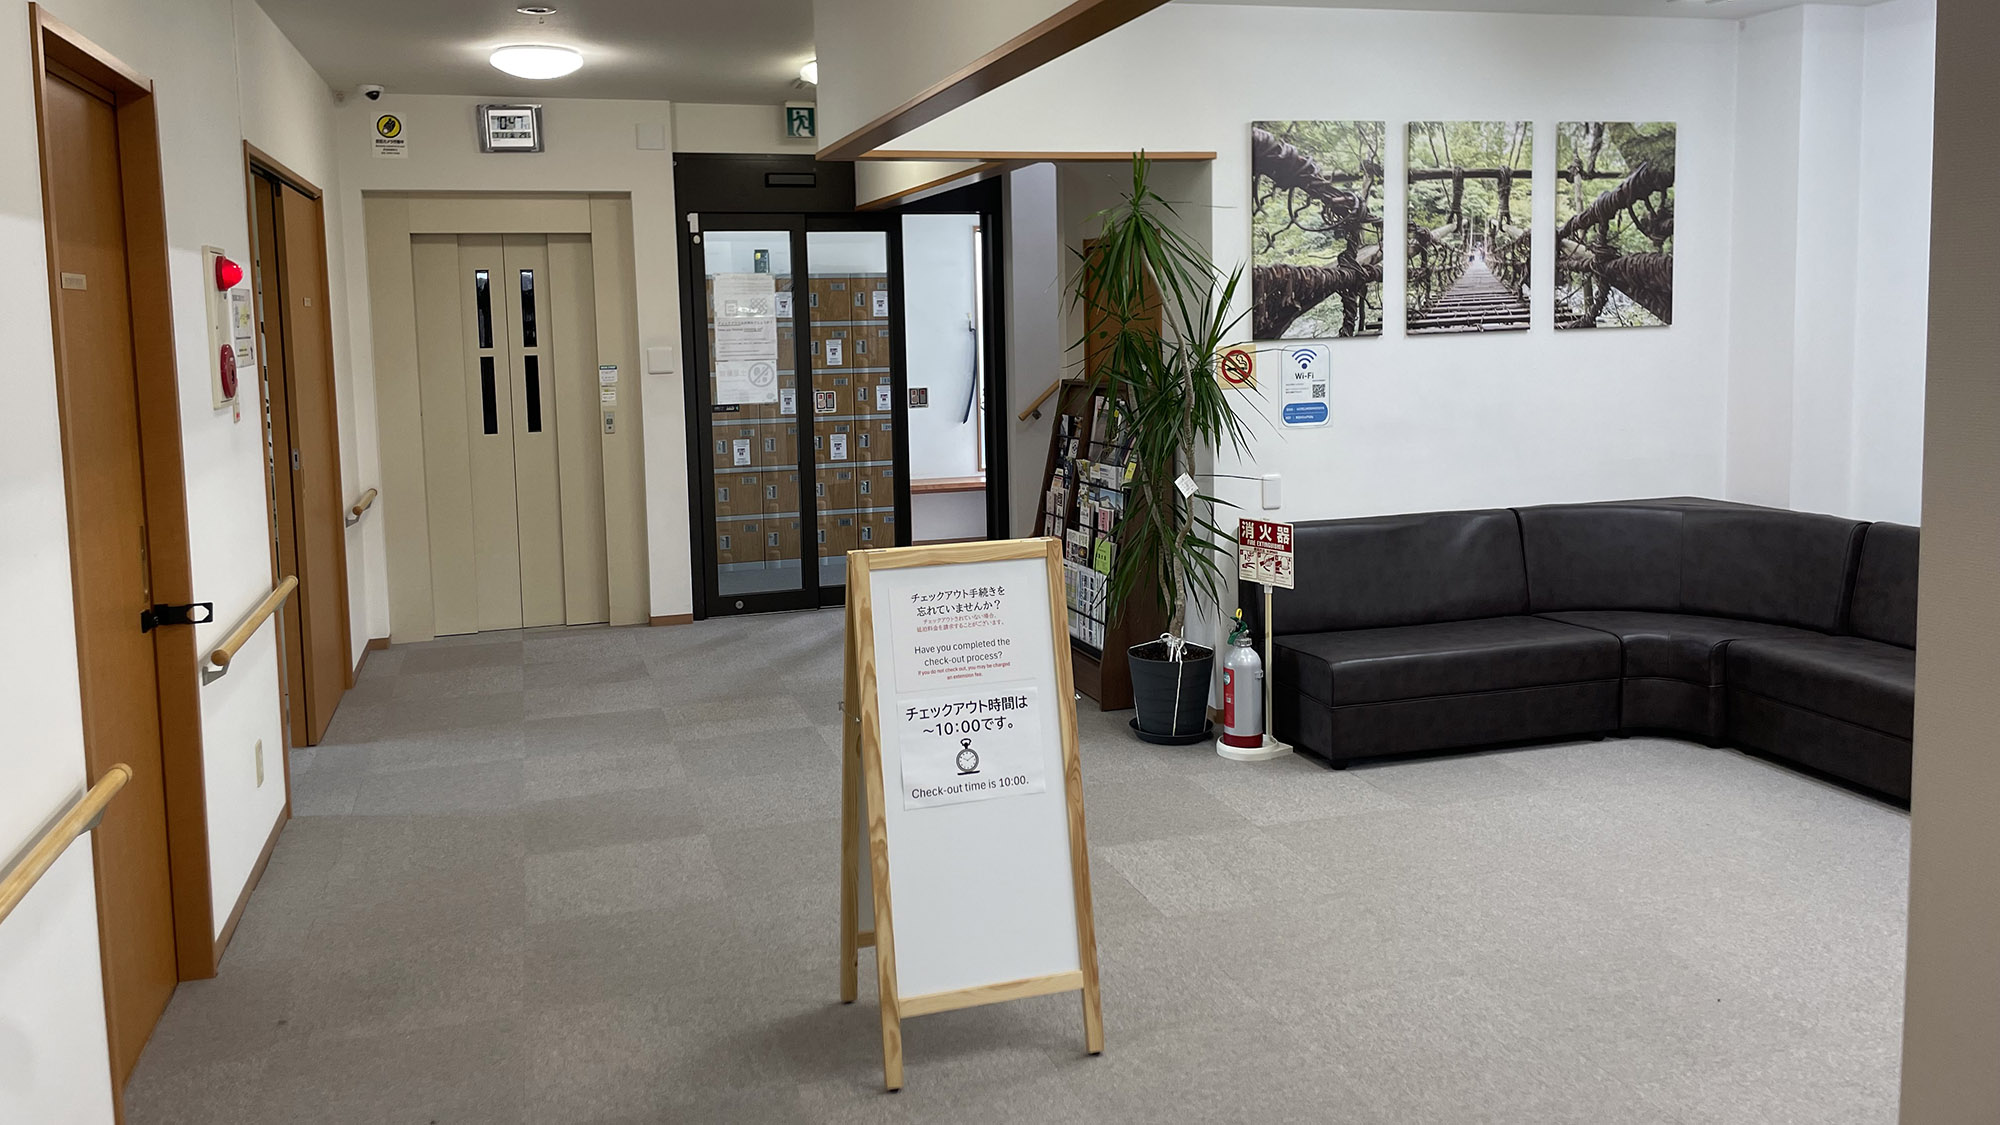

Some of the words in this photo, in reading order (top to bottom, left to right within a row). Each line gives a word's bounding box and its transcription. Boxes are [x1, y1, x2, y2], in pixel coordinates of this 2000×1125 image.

[1295, 372, 1314, 380] Wi-Fi
[1241, 520, 1290, 545] 消火器
[911, 585, 1005, 604] チェックアウト手続きを
[916, 599, 1001, 616] 忘れていませんか？
[914, 645, 935, 654] Have
[936, 644, 951, 654] you
[953, 639, 996, 651] completed
[997, 638, 1011, 646] the
[924, 655, 965, 667] check-out
[966, 650, 1003, 664] process?
[945, 665, 958, 673] check
[993, 661, 1011, 669] charged
[905, 695, 1028, 722] チェックアウト時間は
[911, 784, 963, 799] Check-out
[964, 781, 986, 792] time
[988, 779, 997, 788] is
[998, 775, 1029, 788] 10:00.
